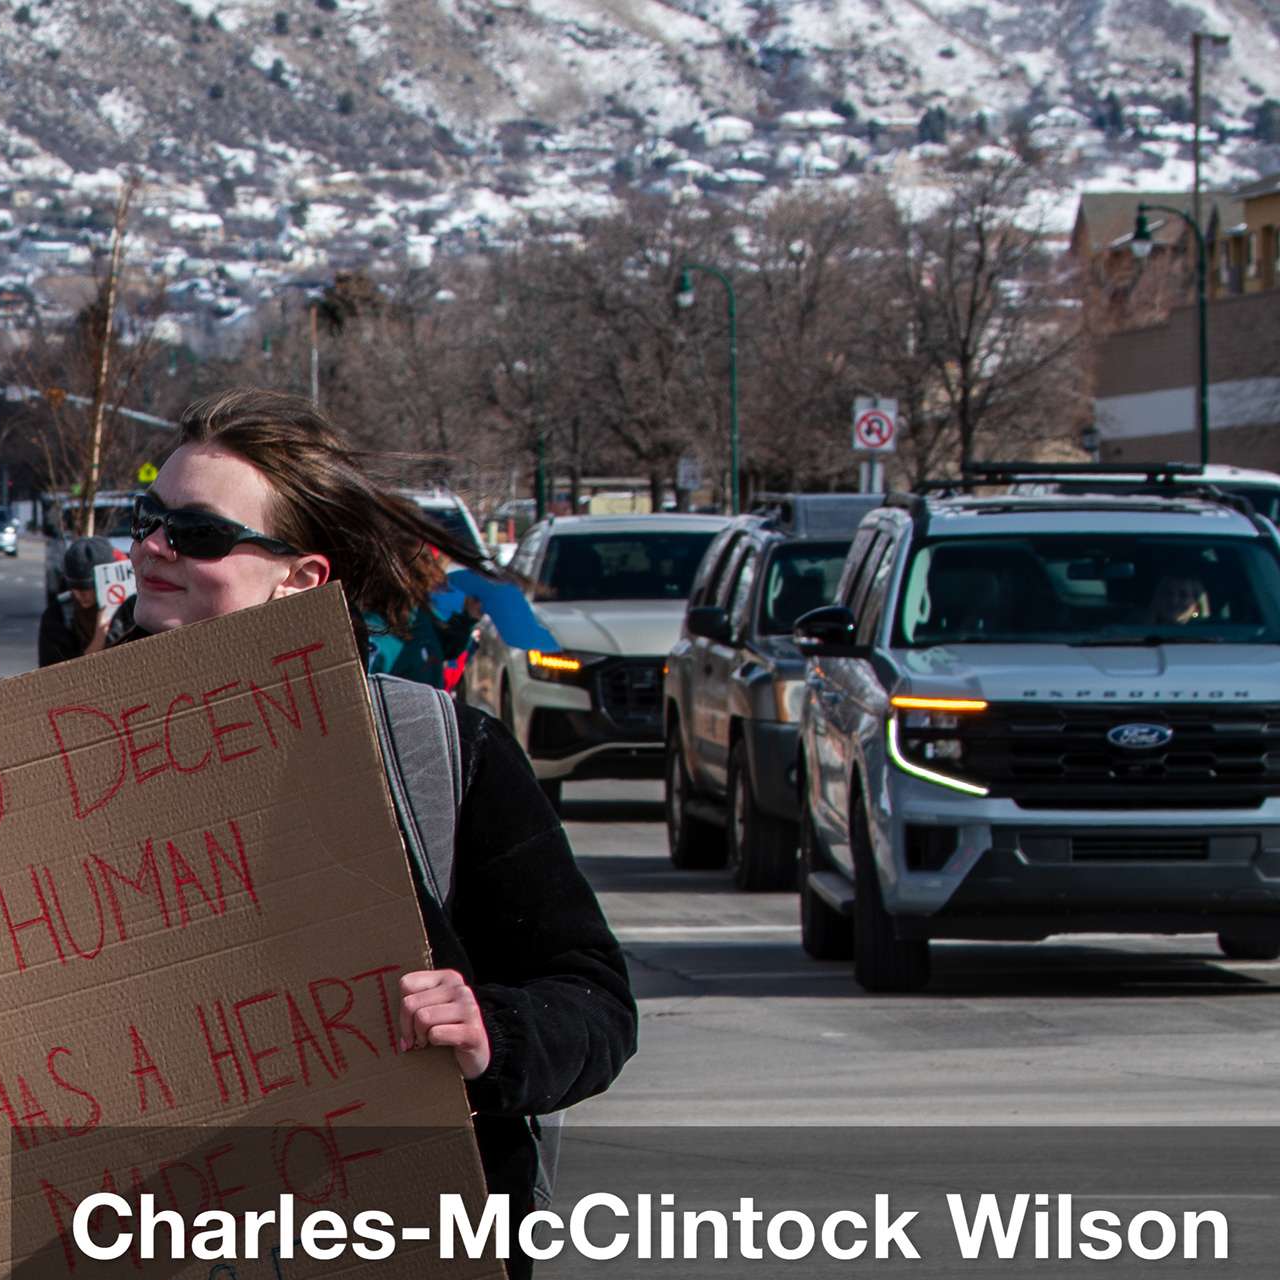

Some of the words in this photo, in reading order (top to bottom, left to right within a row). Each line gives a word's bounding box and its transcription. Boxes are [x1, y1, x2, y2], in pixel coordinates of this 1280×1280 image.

[48, 640, 328, 820] DECENT
[1118, 726, 1161, 745] Ford
[129, 1025, 180, 1113] A
[196, 964, 402, 1105] HEART
[272, 1101, 385, 1205] OF
